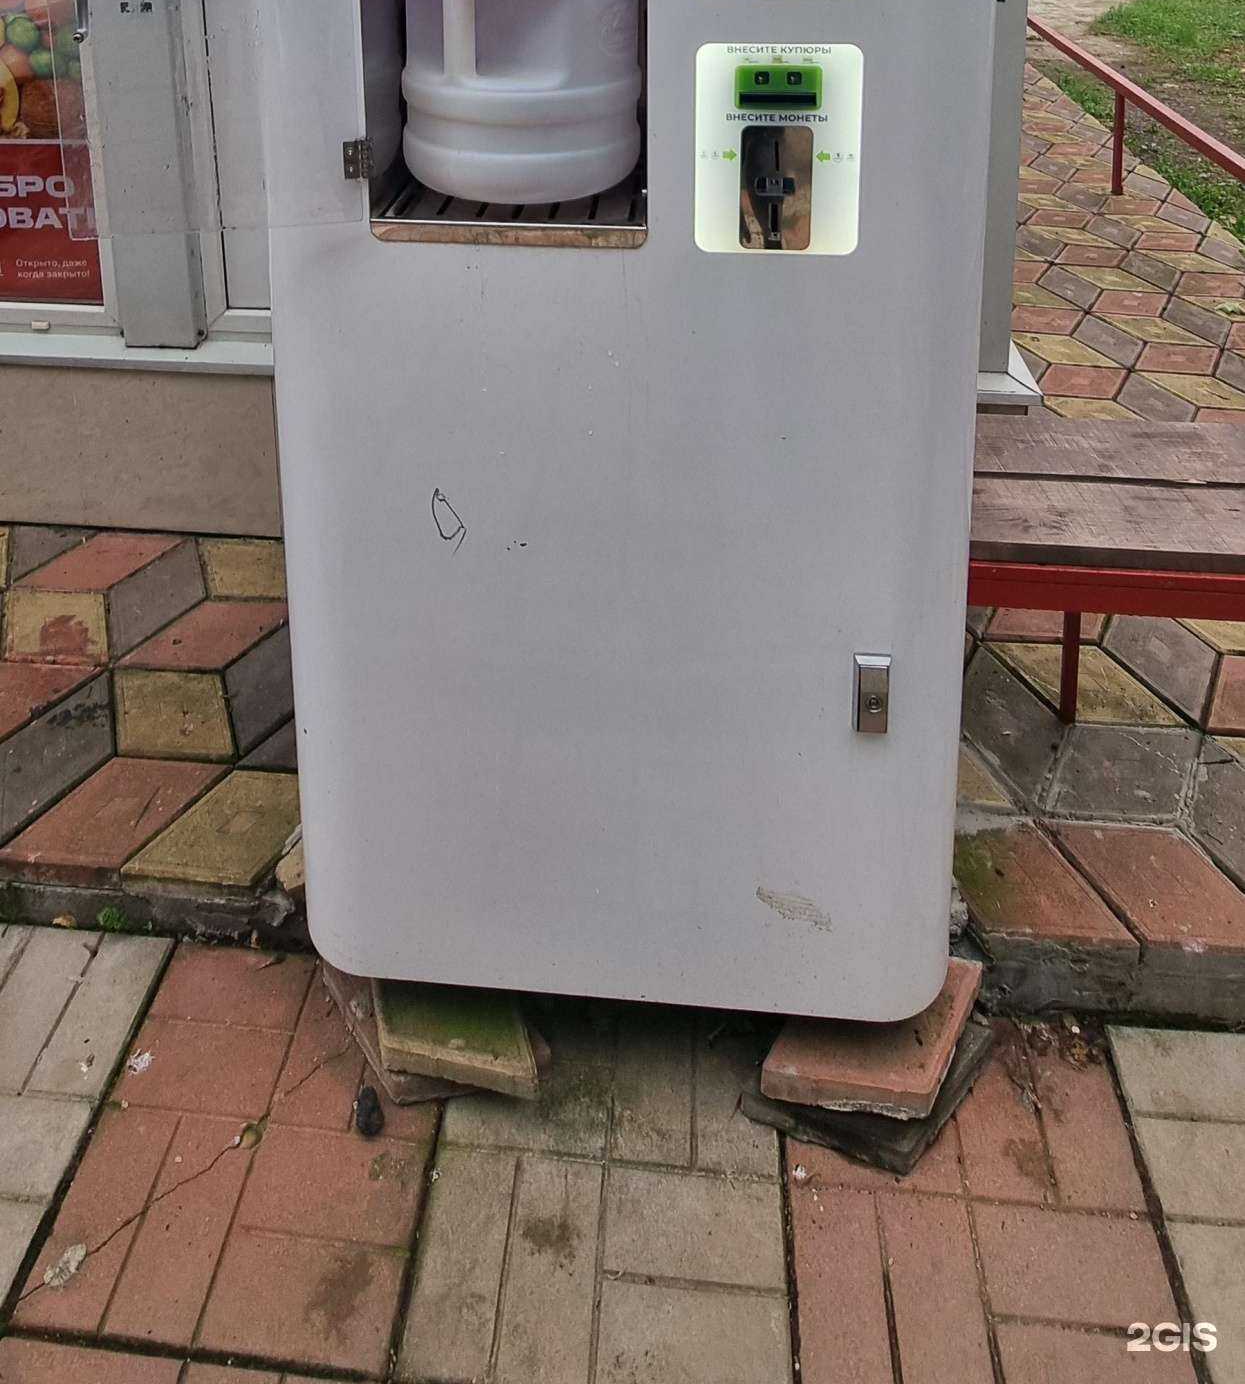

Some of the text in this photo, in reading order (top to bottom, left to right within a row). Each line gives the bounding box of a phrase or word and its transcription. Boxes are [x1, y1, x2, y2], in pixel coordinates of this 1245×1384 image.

[727, 46, 831, 54] ВНЕСИТЕ КУПЮРЫ
[726, 113, 828, 122] ВНЕСИТЕ МОНЕТЫ
[16, 258, 87, 268] Открыто, даже
[18, 270, 90, 279] когда закрыто!
